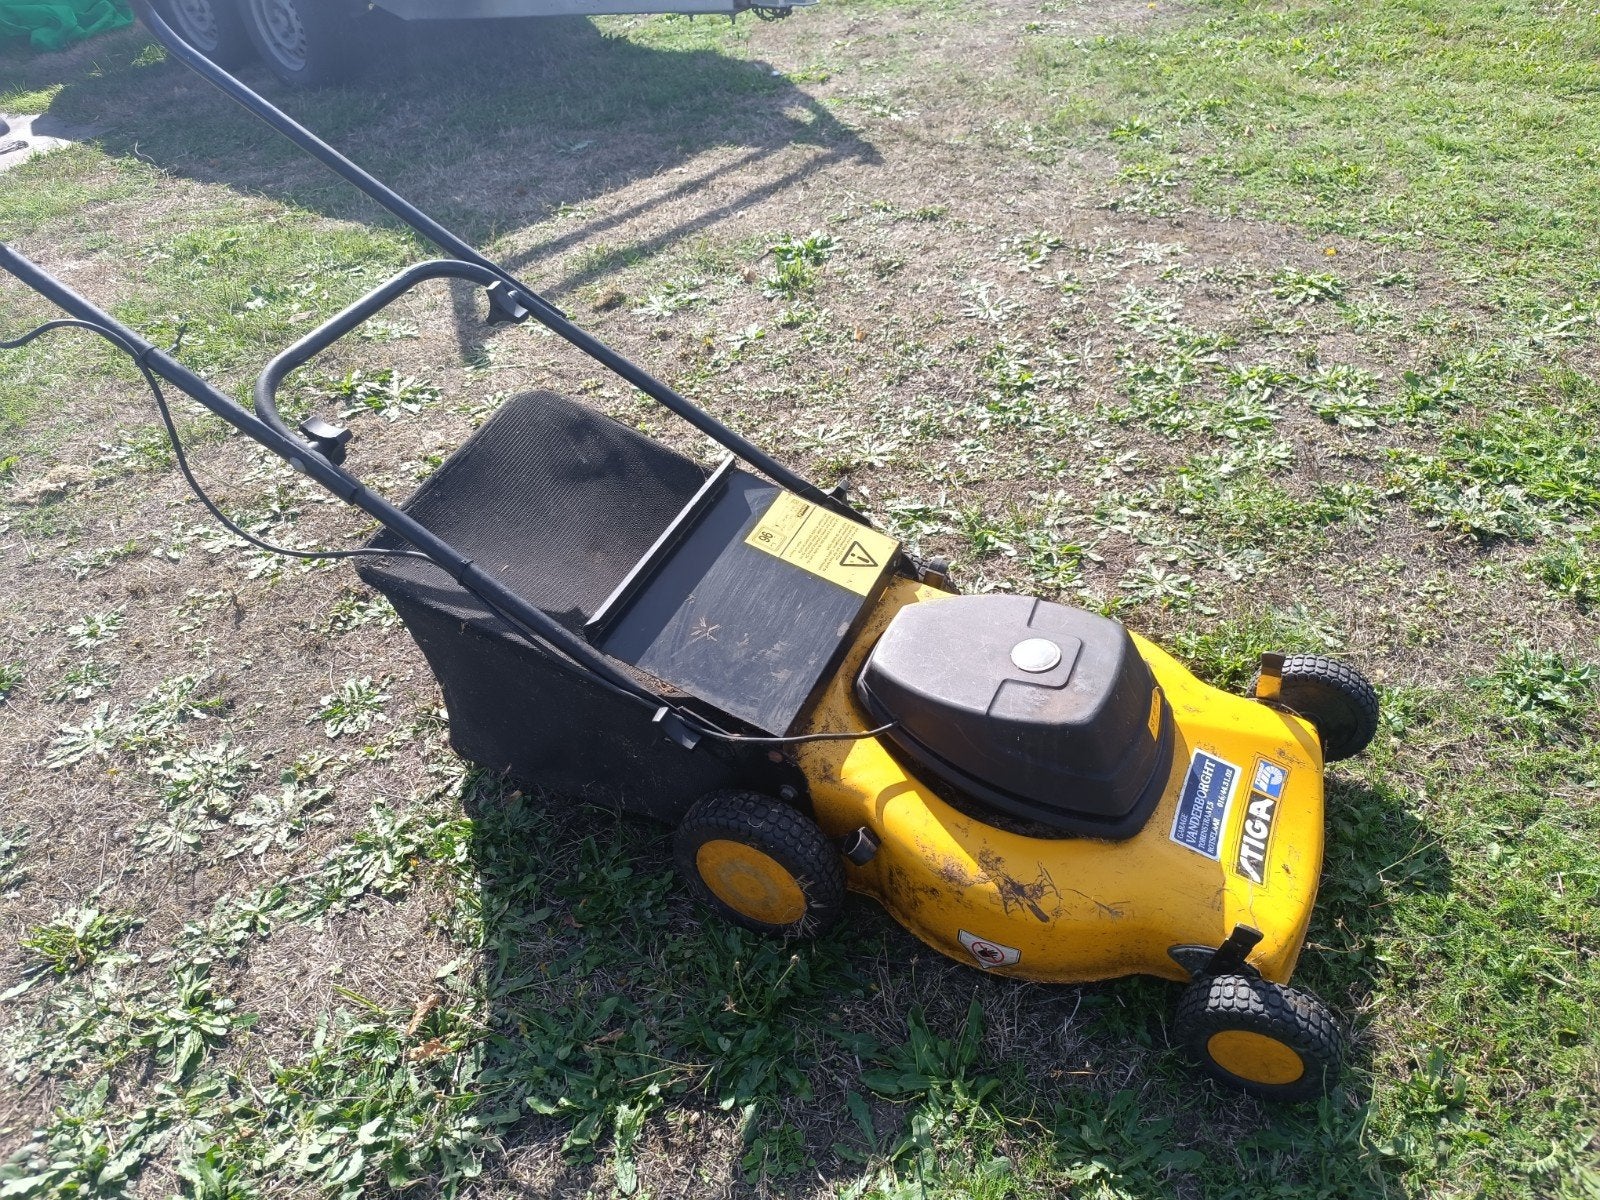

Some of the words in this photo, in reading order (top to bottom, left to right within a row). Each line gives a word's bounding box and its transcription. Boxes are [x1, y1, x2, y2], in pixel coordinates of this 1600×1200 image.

[1176, 812, 1189, 839] GARAGE
[1186, 759, 1216, 844] VANDERBORGHT
[1207, 817, 1221, 854] ROTSELAAR
[1239, 798, 1275, 884] STIGA
